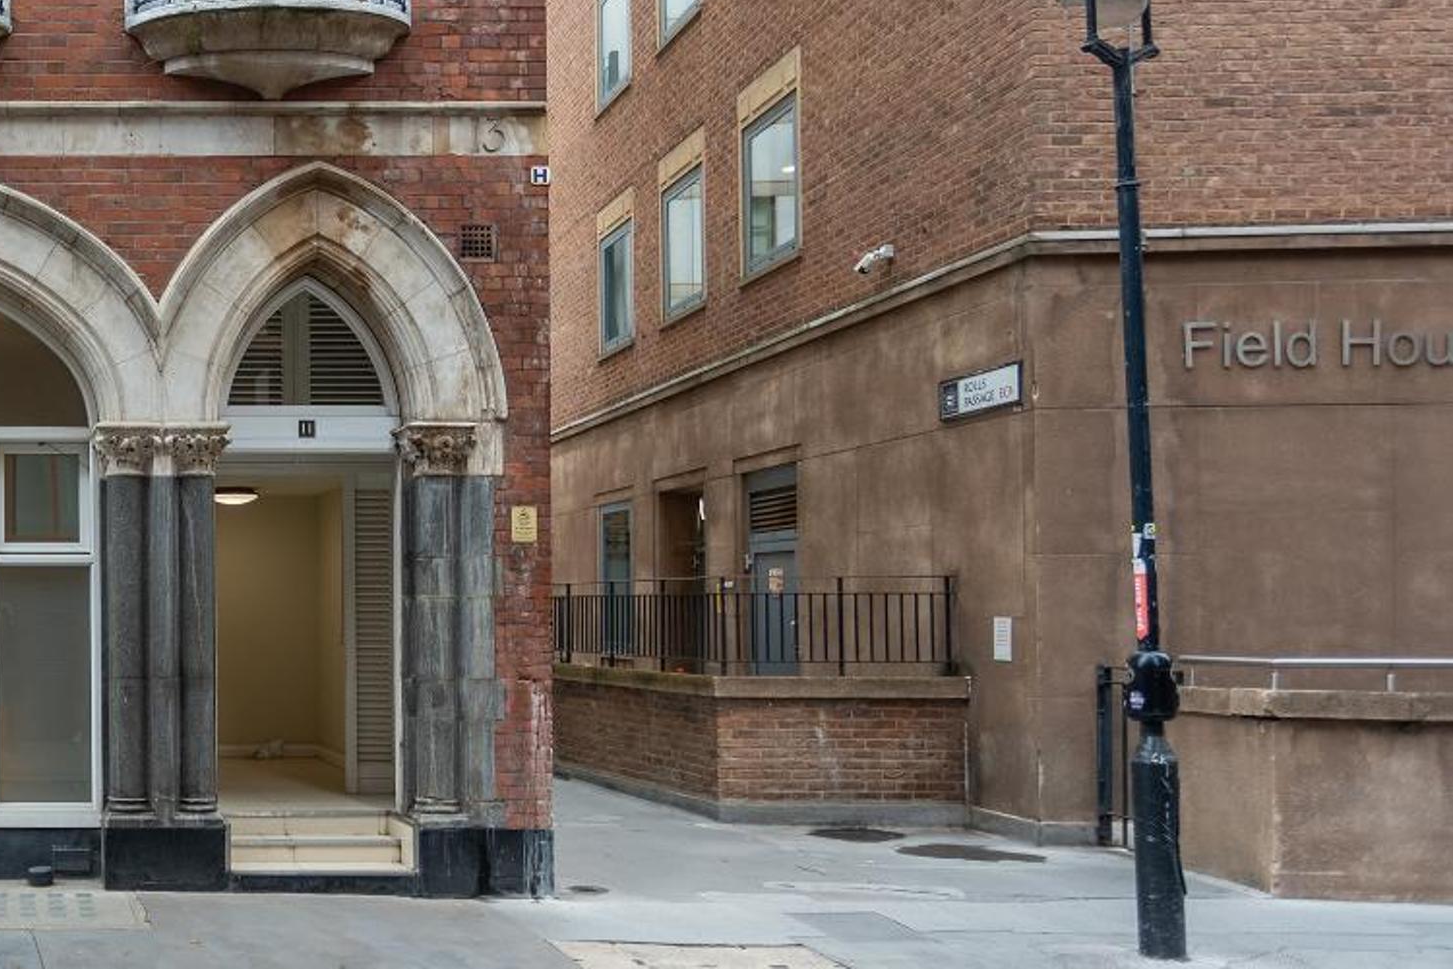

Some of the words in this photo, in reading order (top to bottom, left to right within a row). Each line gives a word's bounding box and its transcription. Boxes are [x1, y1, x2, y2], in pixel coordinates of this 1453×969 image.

[533, 168, 548, 183] H
[1182, 320, 1317, 369] Field
[1342, 319, 1453, 367] Hou
[963, 377, 987, 393] ROLLS
[963, 388, 997, 407] PASSAGE
